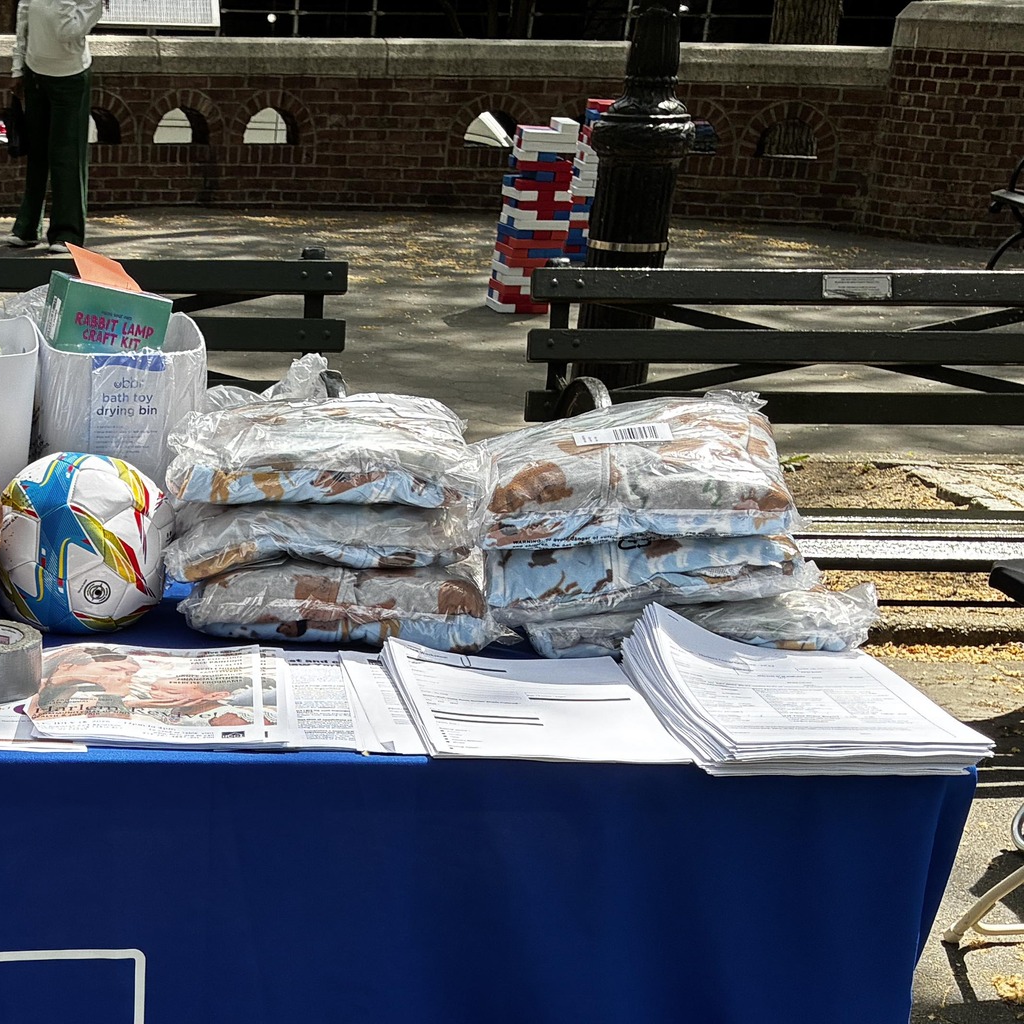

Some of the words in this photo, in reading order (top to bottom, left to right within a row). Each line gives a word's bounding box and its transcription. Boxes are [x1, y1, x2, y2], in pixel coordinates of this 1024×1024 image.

[74, 312, 119, 333] RABBIT
[122, 322, 154, 340] LAMP
[82, 328, 118, 346] CRAFT
[120, 336, 141, 349] KIT
[113, 378, 143, 390] ubbi
[102, 391, 131, 403] bath
[134, 393, 154, 407] toy
[96, 405, 135, 418] drying
[138, 405, 158, 416] bin
[35, 703, 118, 714] Harlem
